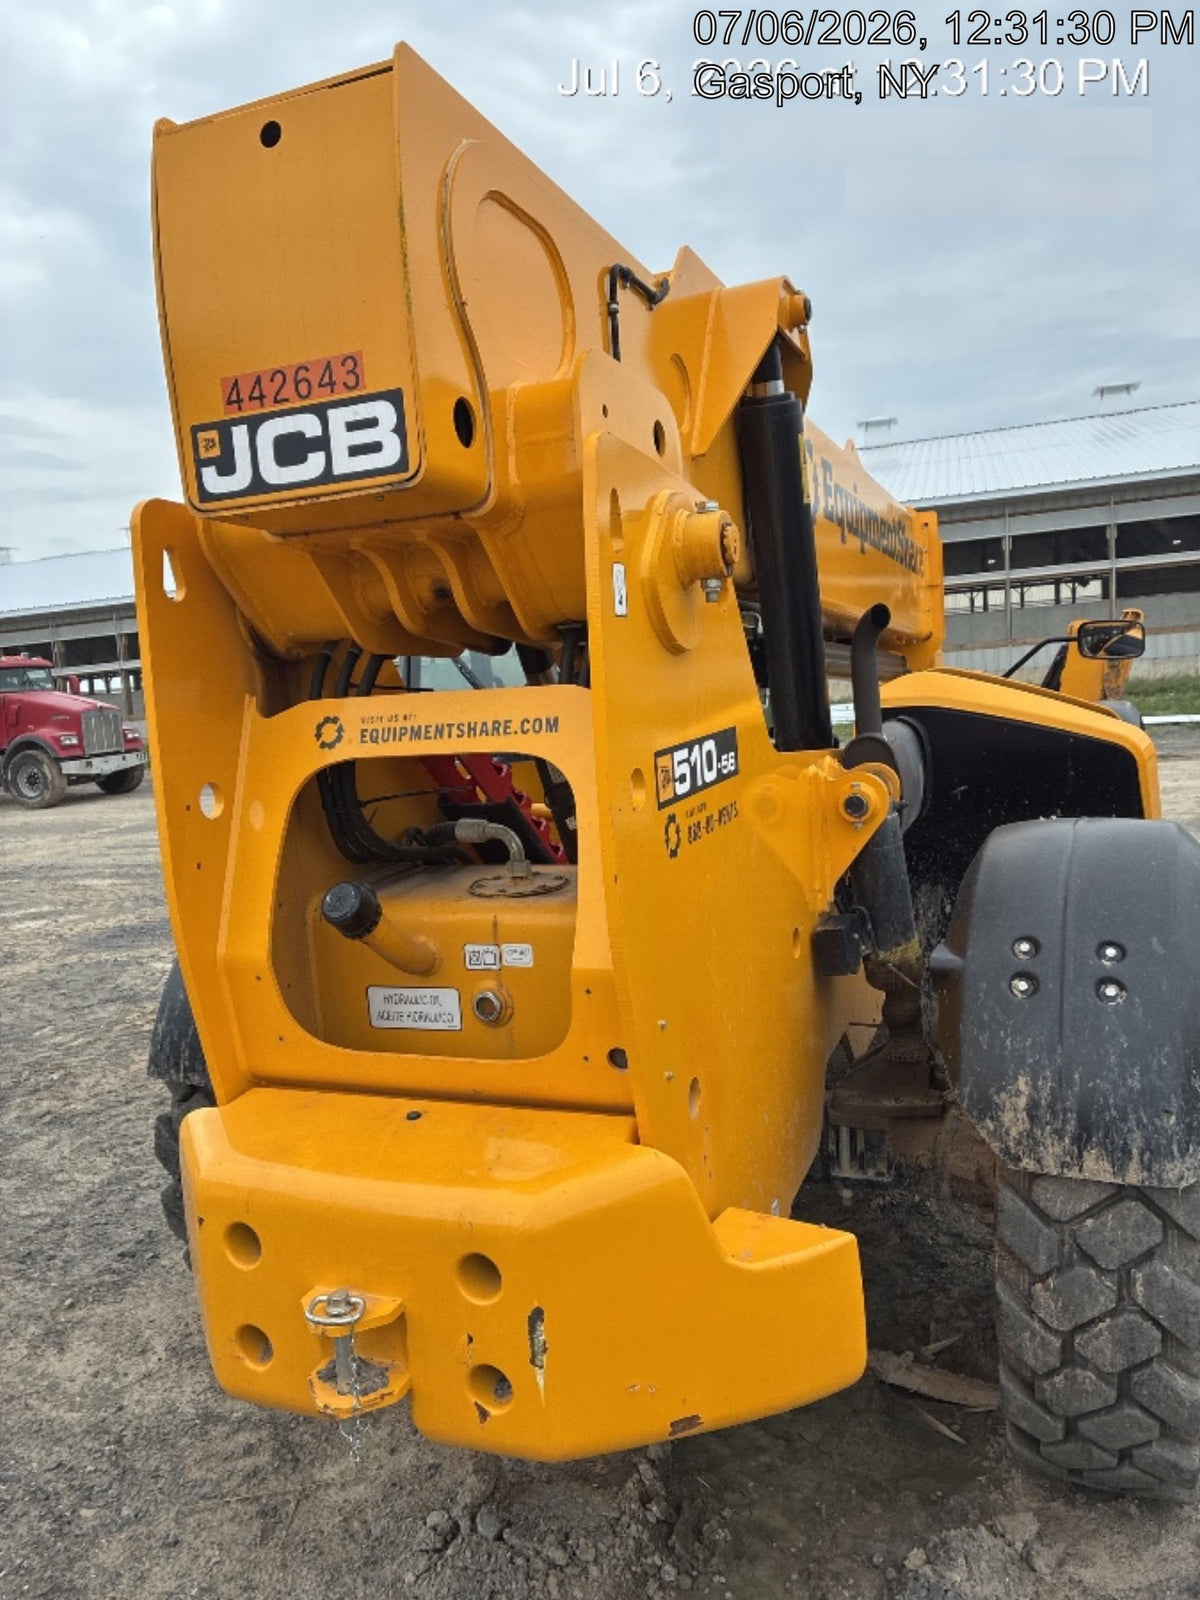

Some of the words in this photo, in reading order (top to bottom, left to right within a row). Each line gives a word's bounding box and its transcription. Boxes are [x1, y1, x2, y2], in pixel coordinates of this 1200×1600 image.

[226, 354, 360, 412] 442643
[200, 400, 402, 494] JCB
[359, 716, 559, 745] EQUIPMENTSHARE.COM
